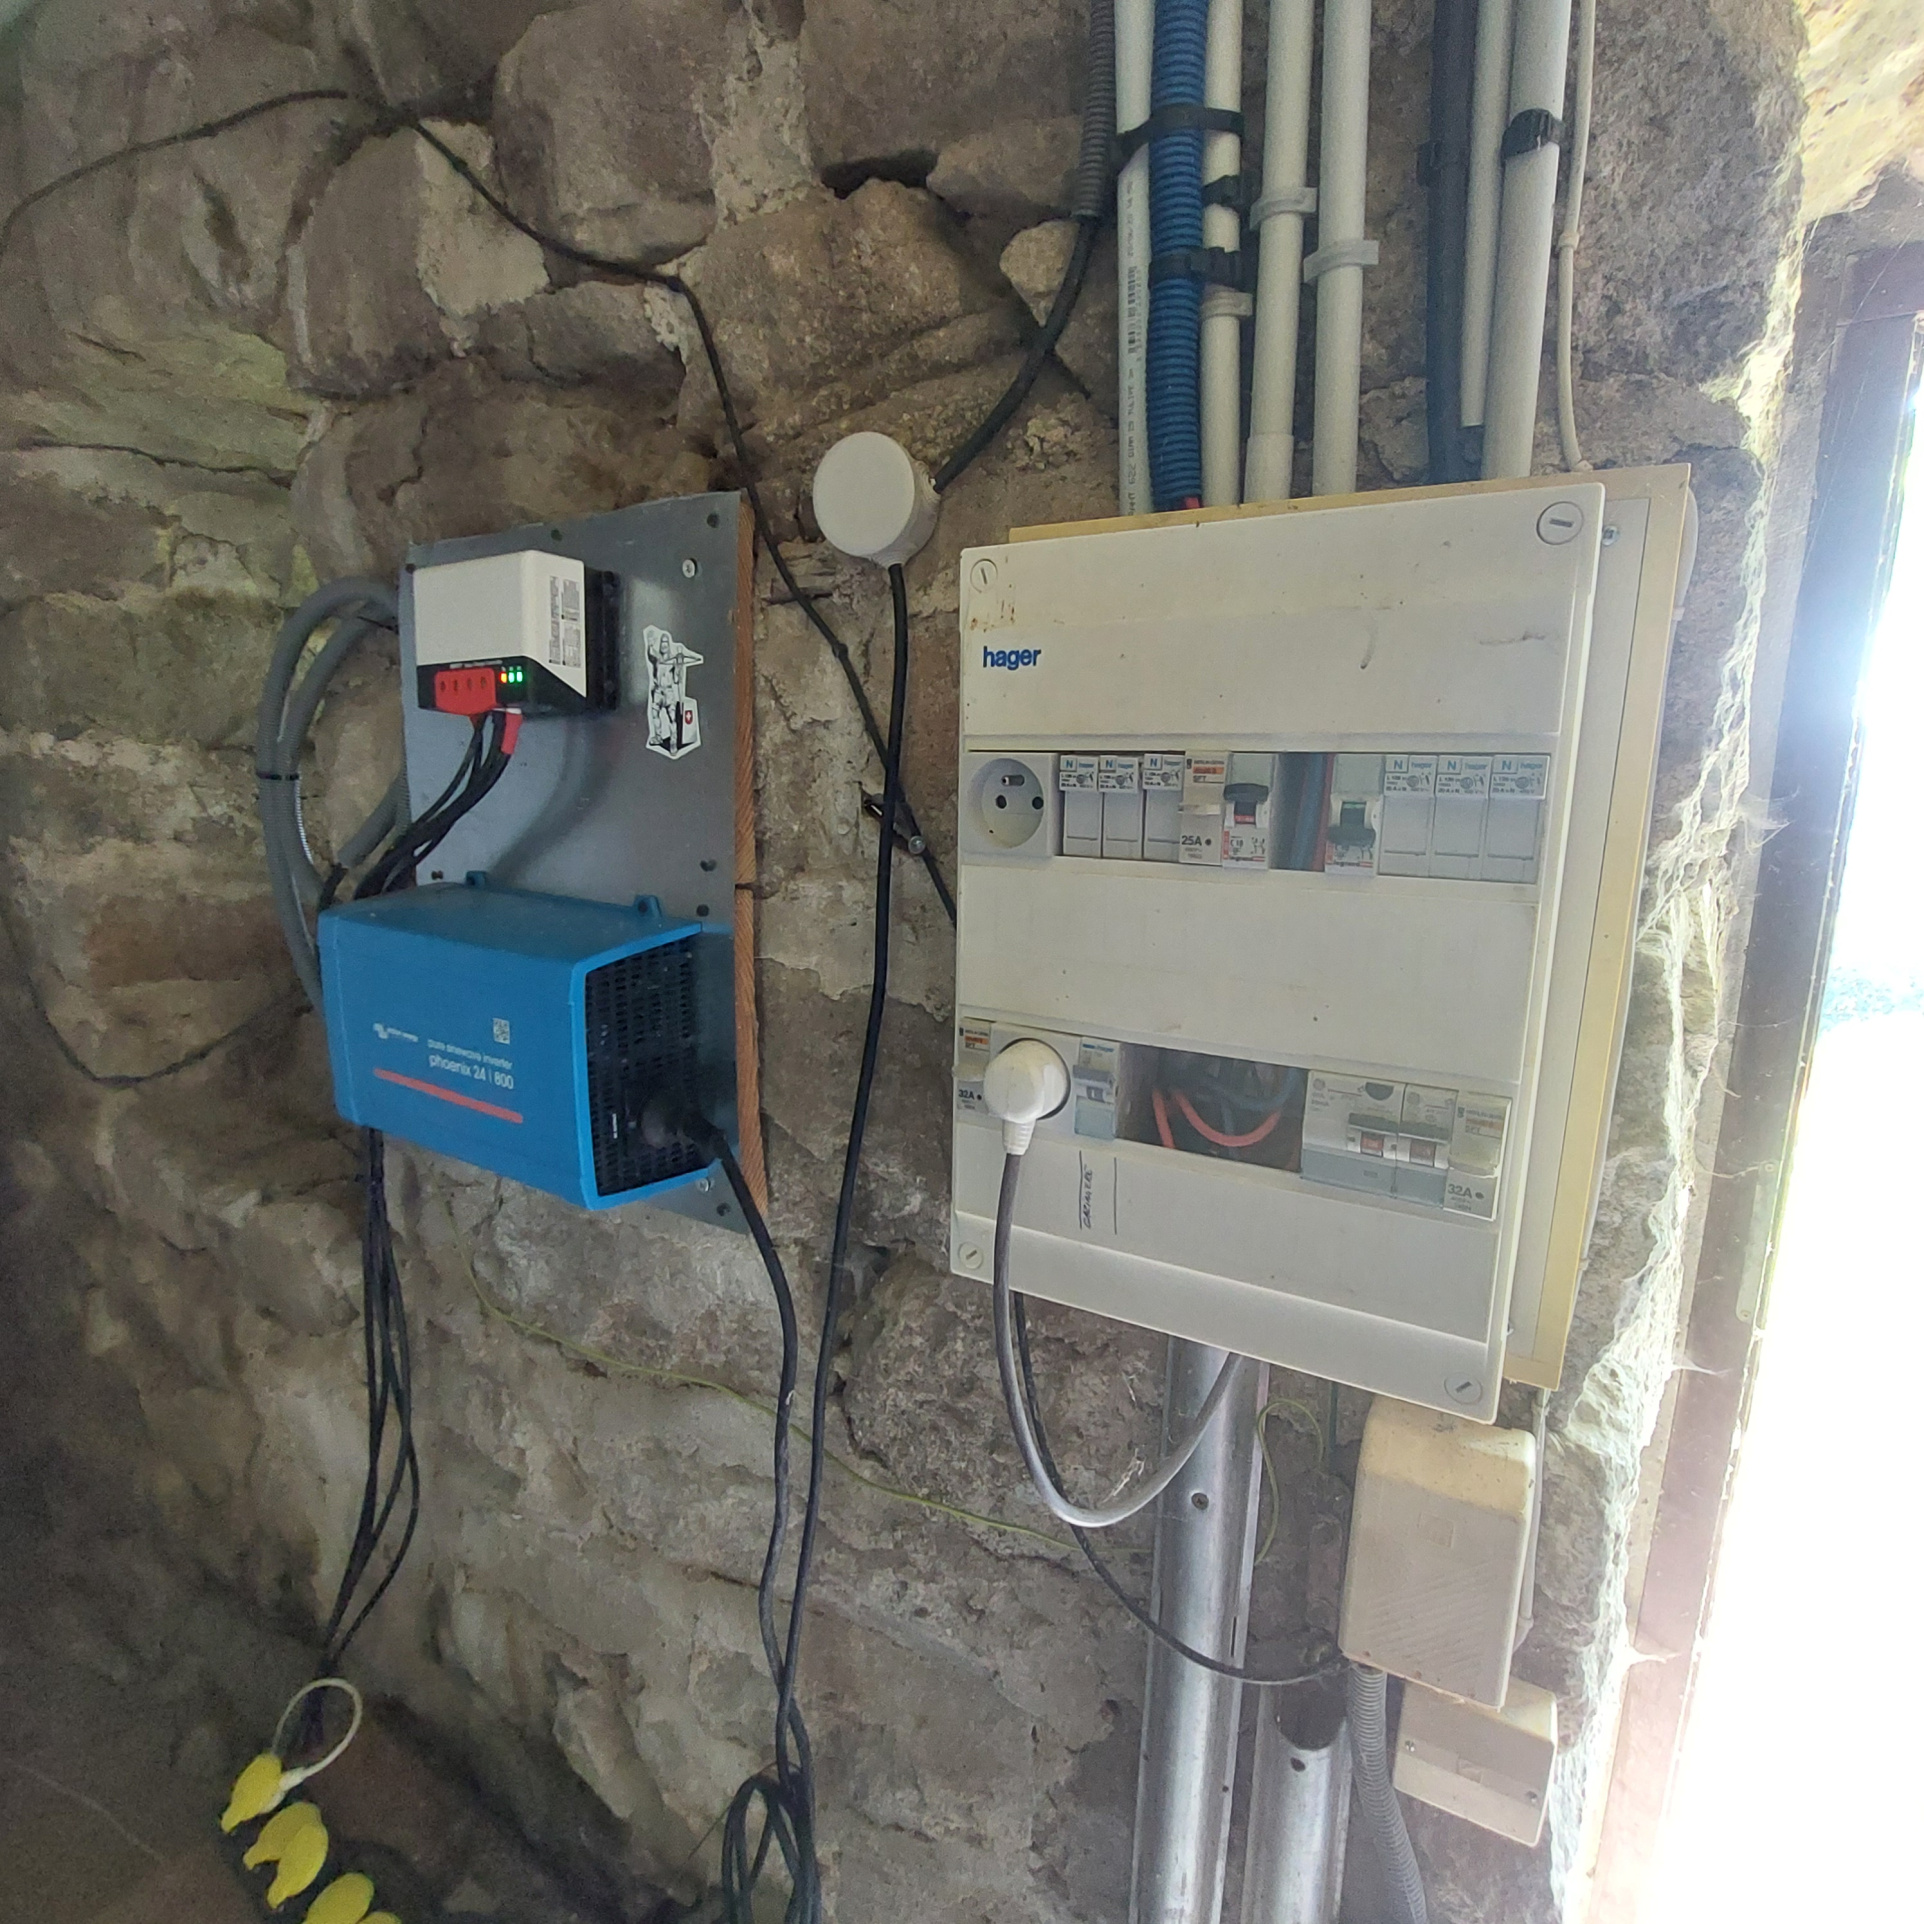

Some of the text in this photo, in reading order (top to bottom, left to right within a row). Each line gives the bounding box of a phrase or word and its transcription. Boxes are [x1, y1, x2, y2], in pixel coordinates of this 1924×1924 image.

[983, 645, 1042, 671] hager
[1066, 759, 1073, 768] N
[1106, 759, 1113, 768] N
[1150, 758, 1157, 767] N
[1394, 759, 1403, 770] N
[1447, 760, 1457, 771] N
[1502, 759, 1511, 770] N
[1181, 835, 1202, 846] 25A
[428, 1054, 472, 1078] phoenix
[958, 1089, 975, 1100] 32A
[1448, 1184, 1473, 1199] 32A
